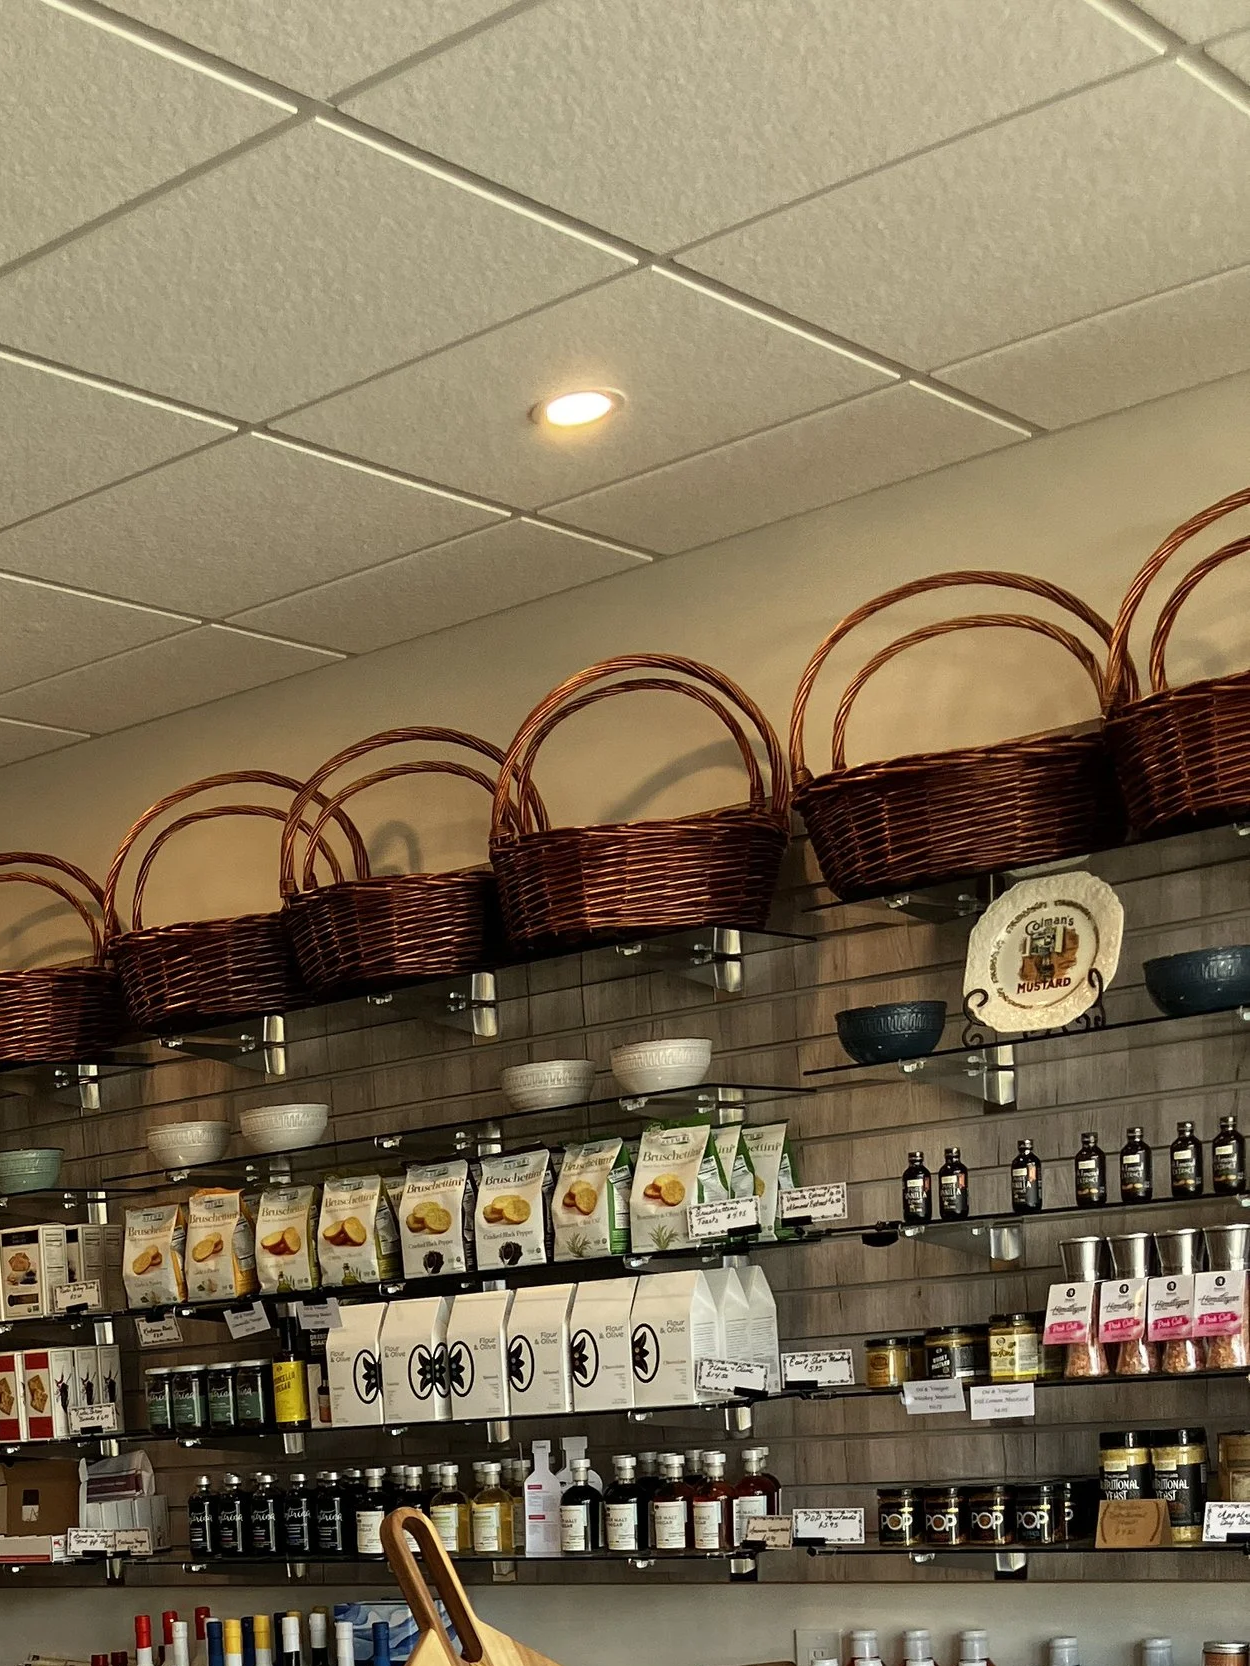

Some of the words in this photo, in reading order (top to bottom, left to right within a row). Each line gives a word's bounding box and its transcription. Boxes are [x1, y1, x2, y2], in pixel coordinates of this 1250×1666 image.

[1025, 915, 1074, 937] Colman's
[1017, 977, 1071, 994] MUSTARD
[406, 1177, 465, 1194] Bruschettini
[485, 1169, 545, 1186] Bruschettini
[605, 1325, 624, 1333] Flour
[666, 1320, 685, 1328] Flour
[666, 1325, 685, 1333] Olive
[479, 1337, 496, 1345] Flour
[540, 1331, 557, 1339] Flour
[540, 1337, 557, 1345] Olive
[881, 1513, 913, 1531] POP
[926, 1514, 957, 1531] POP
[972, 1511, 1004, 1530] POP
[1017, 1510, 1049, 1530] POP
